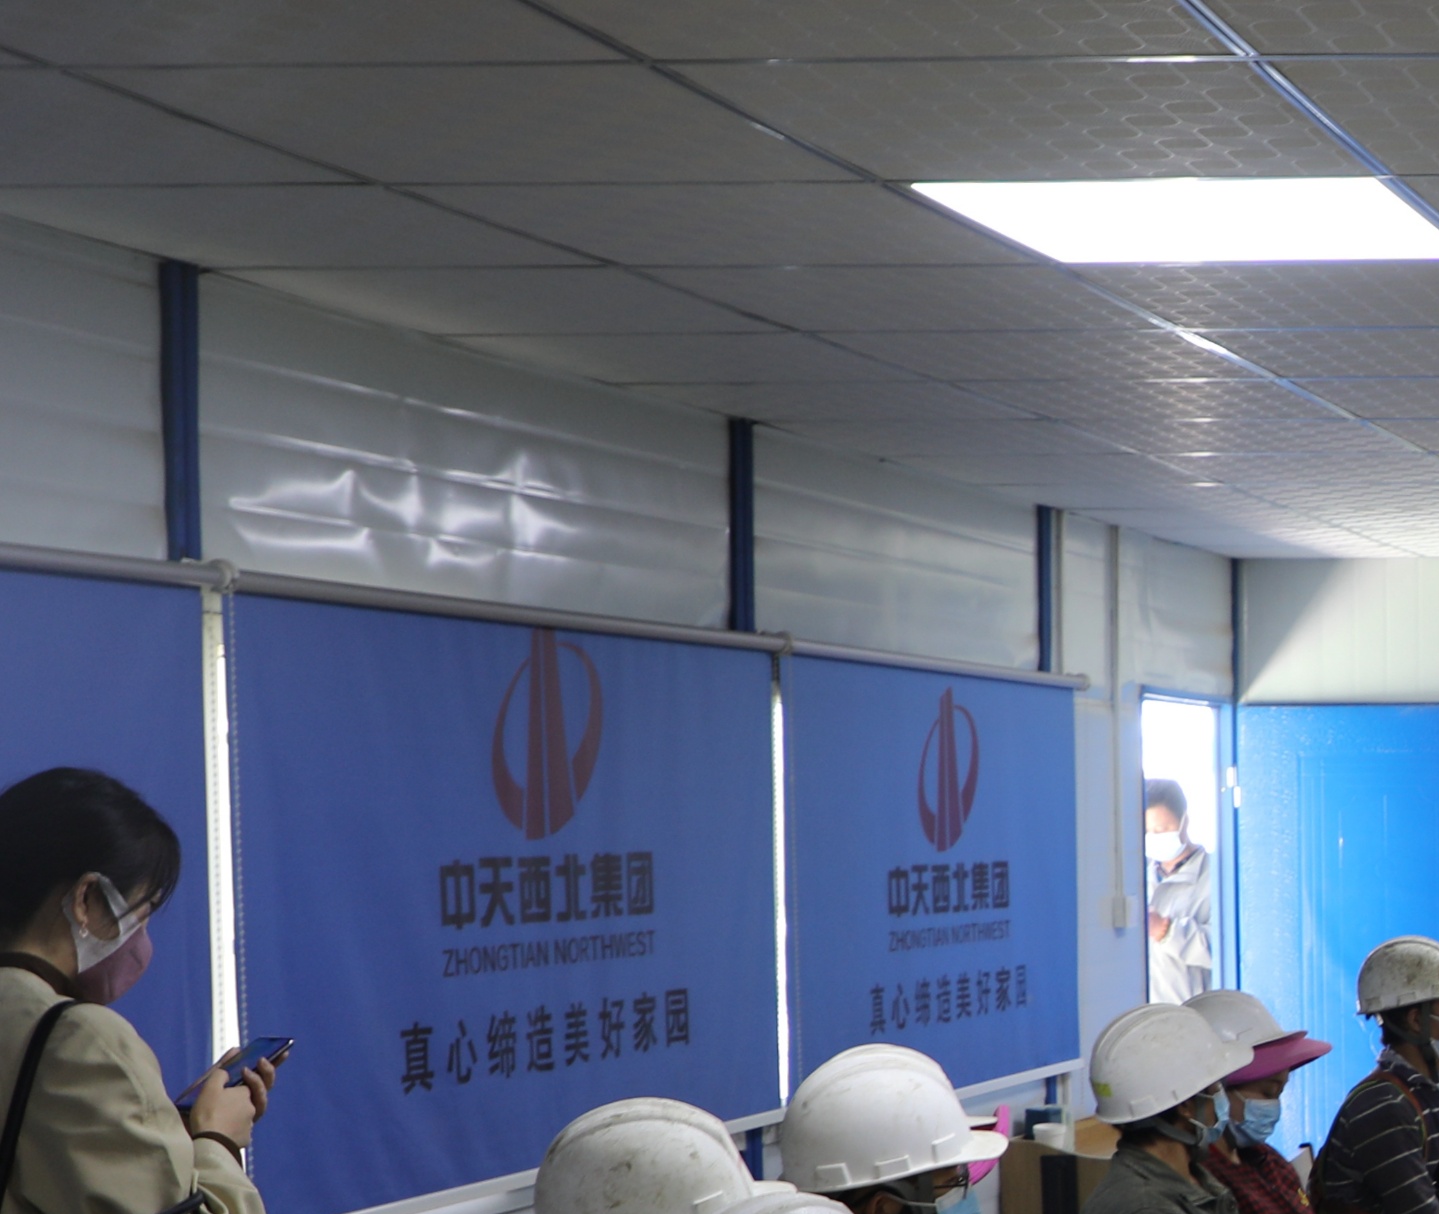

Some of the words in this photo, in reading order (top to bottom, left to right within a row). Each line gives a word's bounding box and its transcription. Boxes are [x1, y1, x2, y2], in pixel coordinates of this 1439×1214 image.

[440, 852, 654, 931] 中天西北集团
[888, 860, 1010, 918] 中天西北集团
[442, 941, 549, 978] ZHONGTIAN
[553, 930, 655, 966] NORTHWEST
[889, 926, 949, 953] ZHONGTIAN
[951, 920, 1010, 946] NORTHWEST
[870, 964, 1028, 1036] 真心缔造美好家园
[401, 987, 690, 1095] 真心缔造美好家园
